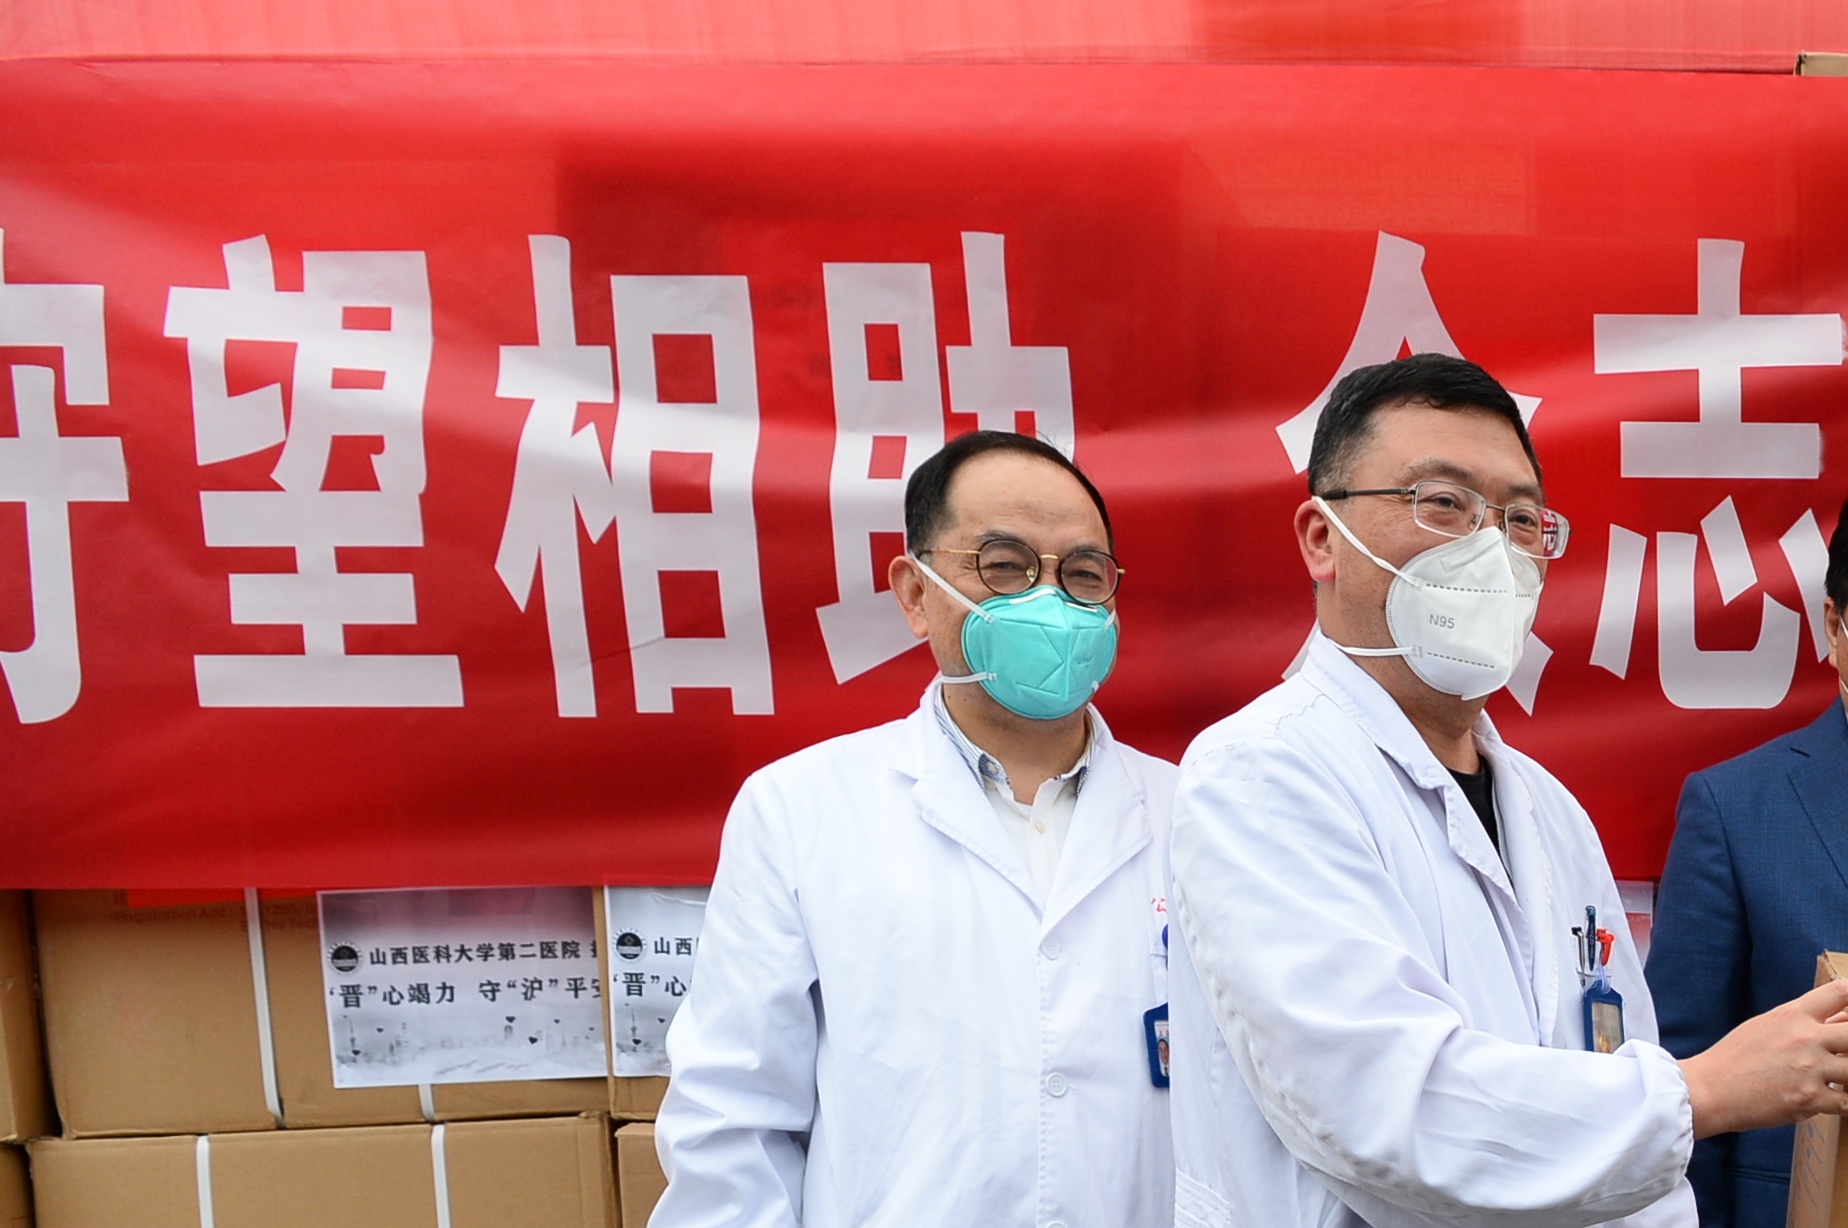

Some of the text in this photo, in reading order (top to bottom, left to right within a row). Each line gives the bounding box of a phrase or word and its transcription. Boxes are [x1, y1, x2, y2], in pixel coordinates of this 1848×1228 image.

[1429, 614, 1455, 629] N95
[369, 940, 581, 966] 山西医科大学第二医院
[653, 936, 700, 957] 山西
